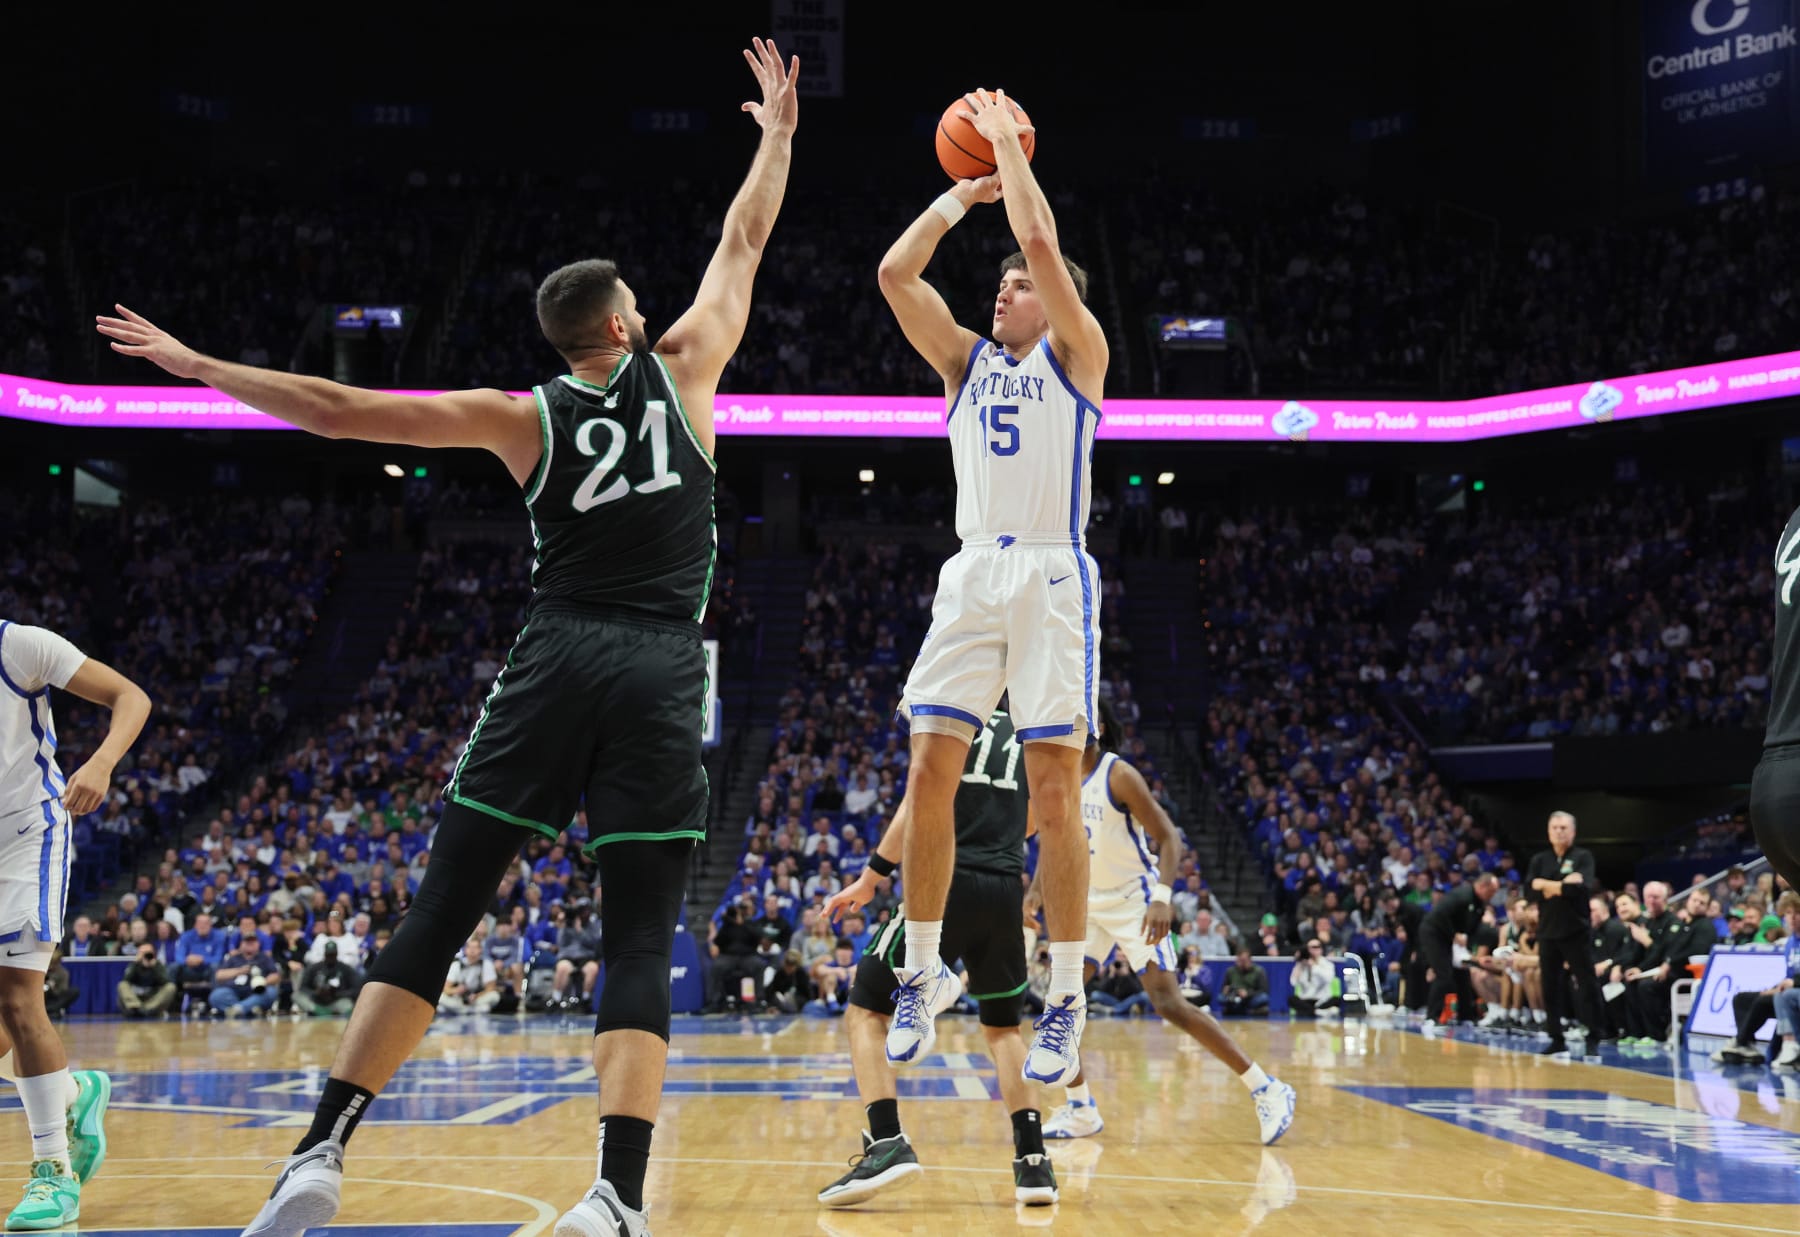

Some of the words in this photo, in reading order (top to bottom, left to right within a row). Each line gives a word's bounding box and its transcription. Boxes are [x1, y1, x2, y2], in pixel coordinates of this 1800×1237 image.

[1647, 38, 1730, 79] Central
[1735, 24, 1797, 59] Bank
[1661, 87, 1717, 111] OFFICIAL
[1720, 76, 1759, 98] BANK
[1762, 70, 1782, 88] OF
[1677, 107, 1697, 123] UK
[1700, 91, 1767, 118] ATHLETICS
[1697, 178, 1747, 205] 225
[969, 372, 1044, 405] KNTUCKY
[1728, 372, 1768, 389] HAND
[116, 401, 157, 414] HAND
[782, 410, 821, 423] HAND
[822, 410, 871, 423] DIPPED
[872, 410, 894, 423] ICE
[895, 410, 942, 423] CREAM
[1105, 414, 1144, 426] HAND
[1145, 414, 1193, 426] DIPPED
[1194, 414, 1216, 426] ICE
[1217, 414, 1264, 426] CREAM
[1427, 415, 1465, 428] HAND
[1466, 410, 1509, 426] DIPPED
[1510, 406, 1529, 420] ICE
[1530, 400, 1572, 417] CREAM
[979, 405, 1020, 457] 15
[572, 400, 682, 512] 21
[961, 727, 1022, 791] 11
